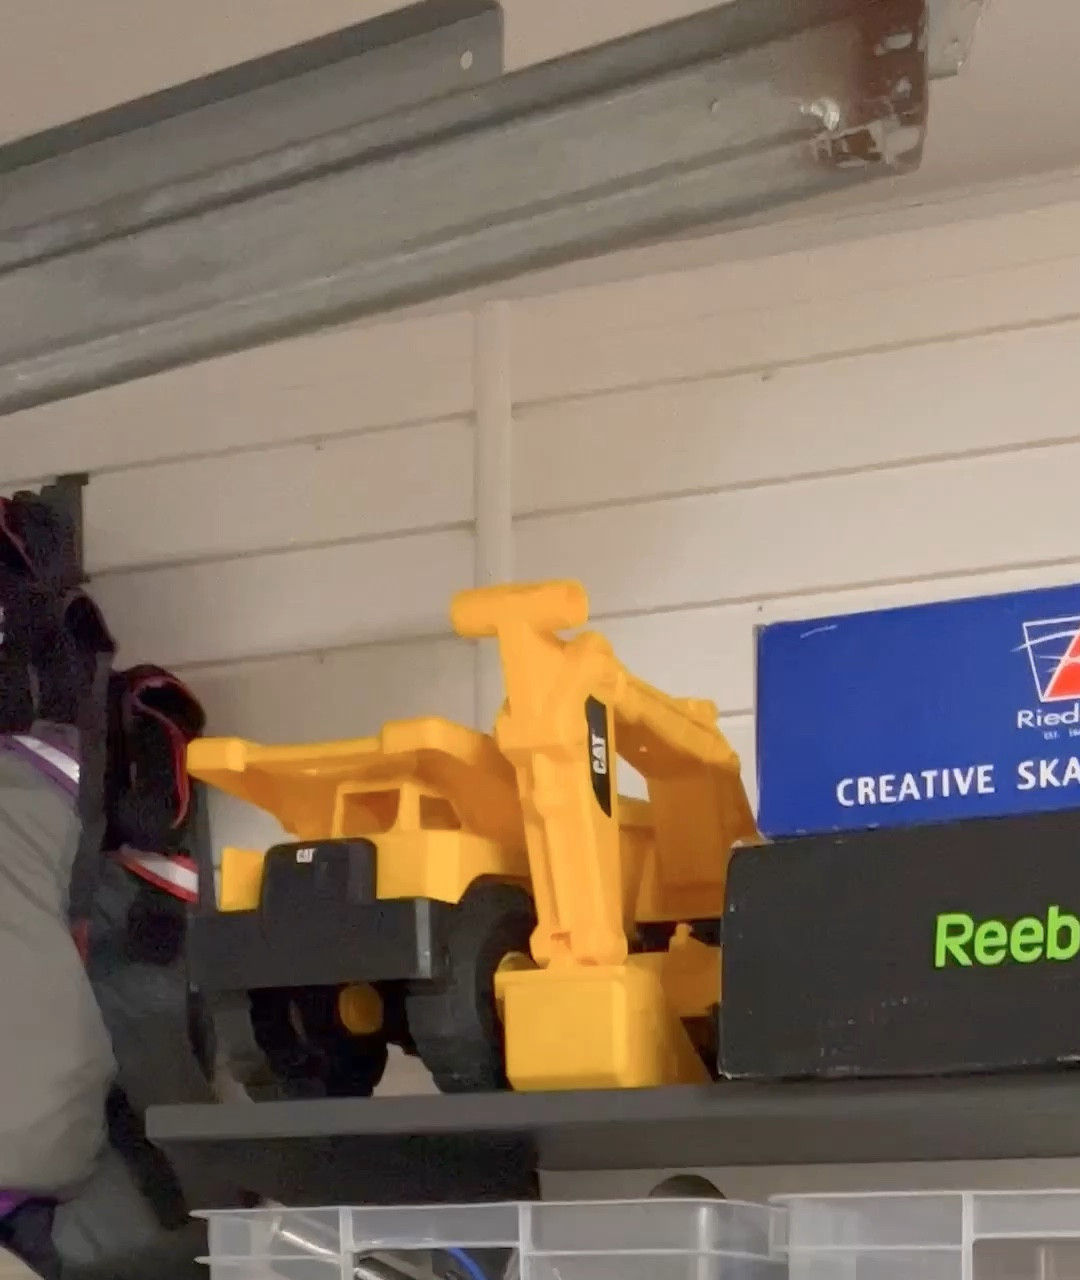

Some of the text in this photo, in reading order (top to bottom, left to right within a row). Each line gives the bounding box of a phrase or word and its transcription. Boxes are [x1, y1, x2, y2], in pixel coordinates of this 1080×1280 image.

[591, 732, 607, 775] CAT
[836, 764, 995, 807] CREATIVE
[295, 847, 317, 864] CAT
